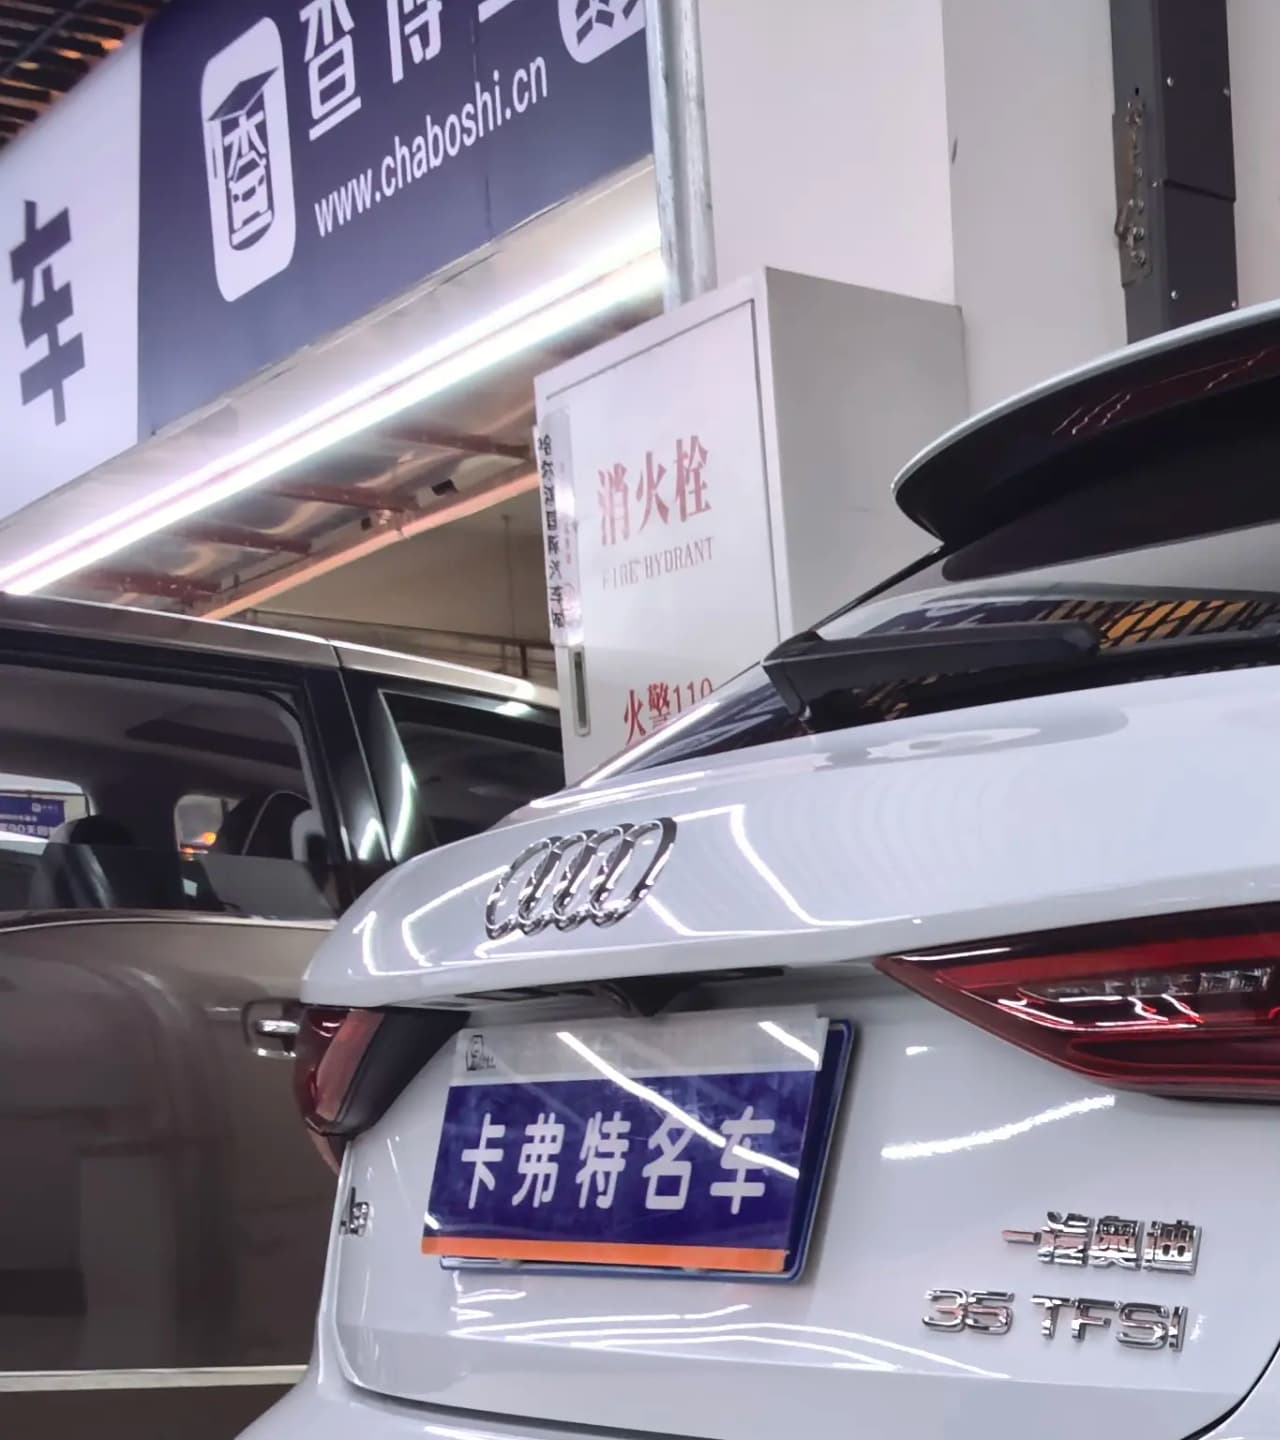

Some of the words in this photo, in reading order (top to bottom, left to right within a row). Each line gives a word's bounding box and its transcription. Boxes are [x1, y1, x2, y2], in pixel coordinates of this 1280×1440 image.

[314, 56, 548, 238] www.chaboshi.cn
[9, 199, 86, 427] 车
[598, 434, 712, 546] 消火栓
[643, 535, 715, 580] HYDRANT
[461, 1105, 776, 1215] 卡弗特名车
[1002, 1211, 1202, 1275] 一汽奥迪
[922, 1289, 1015, 1335] 35
[1030, 1295, 1188, 1352] TFSI
